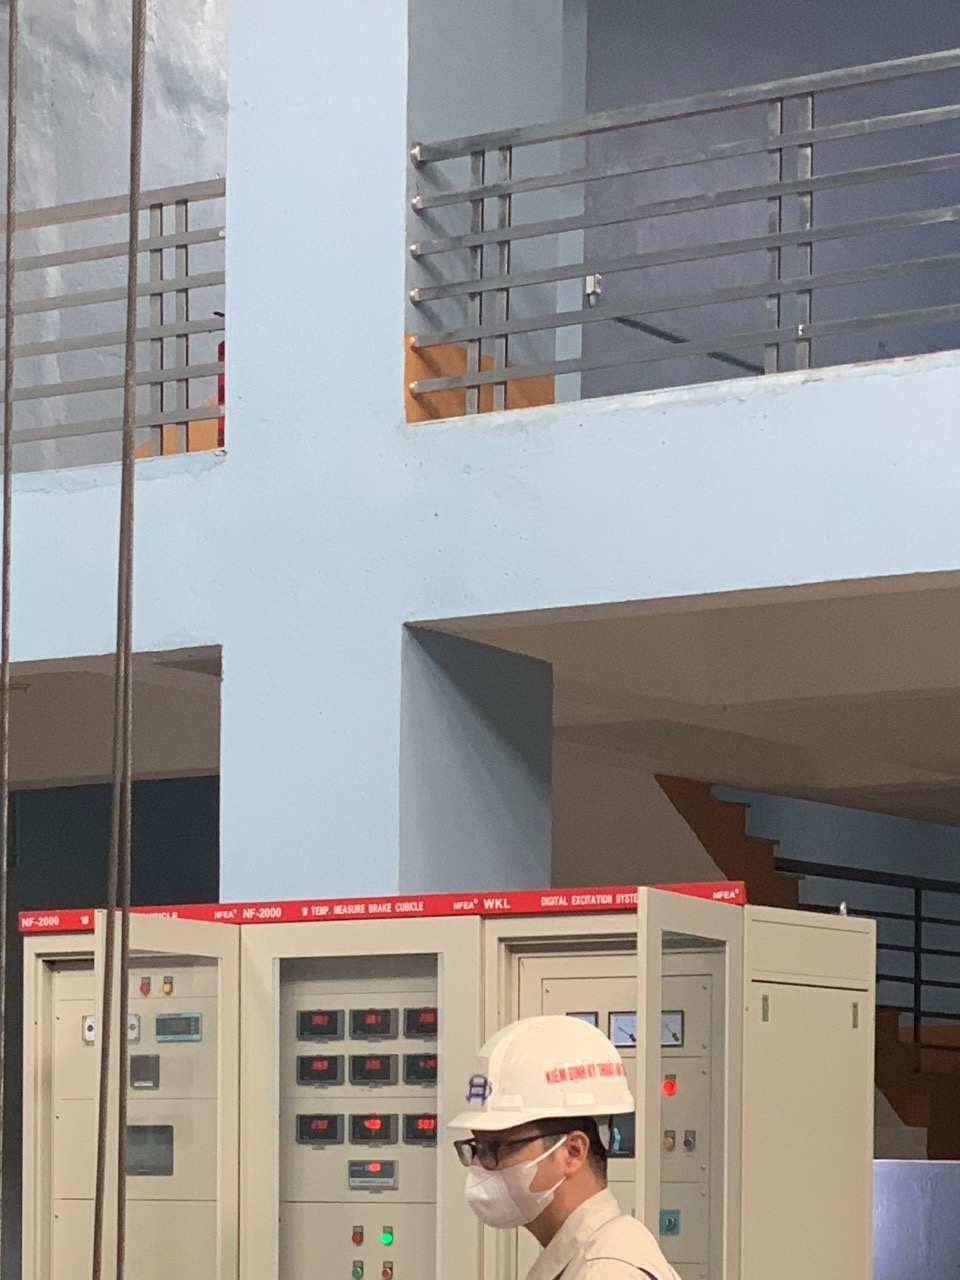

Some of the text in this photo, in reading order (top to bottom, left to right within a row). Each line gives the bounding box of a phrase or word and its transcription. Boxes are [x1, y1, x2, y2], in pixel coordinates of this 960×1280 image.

[484, 898, 511, 909] WKL
[541, 896, 567, 907] DIGITAL
[571, 894, 613, 906] EXCITATION
[242, 907, 282, 919] NF-2000
[333, 904, 366, 915] MEASURE
[368, 902, 392, 913] BRAKE
[395, 901, 424, 912] CUBICLE
[21, 915, 60, 928] NF-2000
